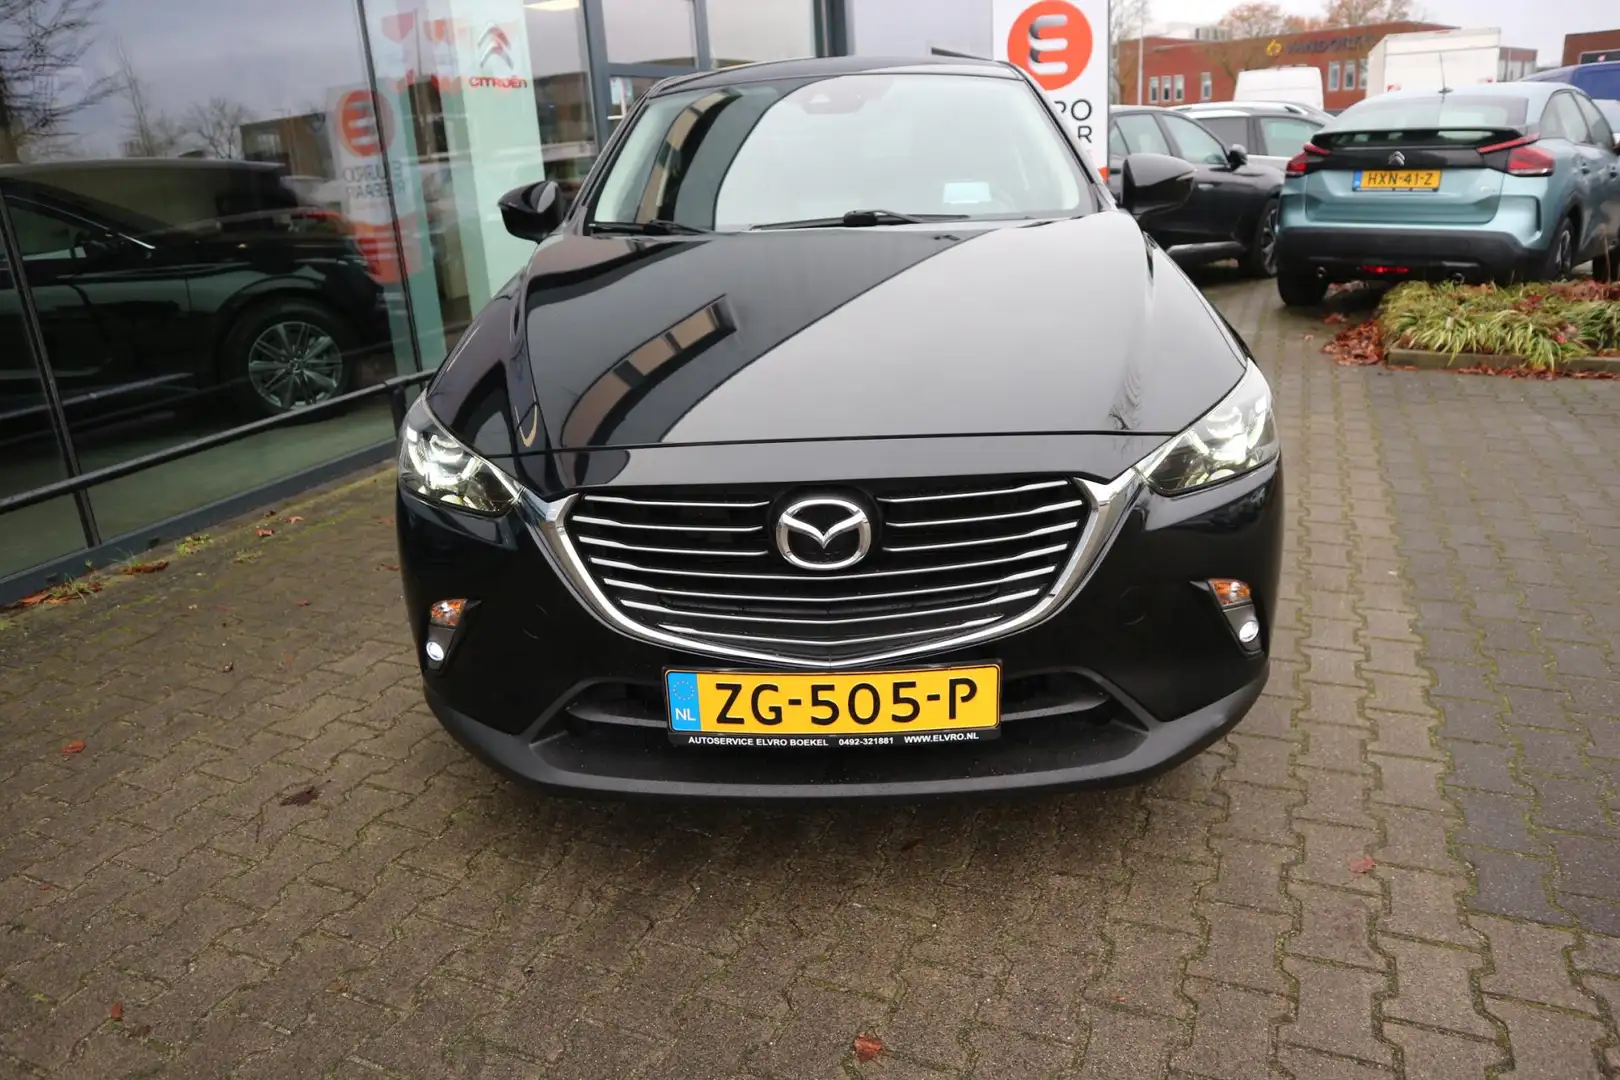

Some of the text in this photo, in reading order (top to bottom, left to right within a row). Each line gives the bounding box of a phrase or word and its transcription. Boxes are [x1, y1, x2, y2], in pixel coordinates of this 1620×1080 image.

[1367, 172, 1434, 186] HXN-41-Z
[715, 678, 978, 726] ZG-505-P
[675, 707, 697, 721] NL
[688, 732, 979, 747] AUTOSERVICE ELVRO BOEKEL 0492-321881 WWW.ELVRO.NL
